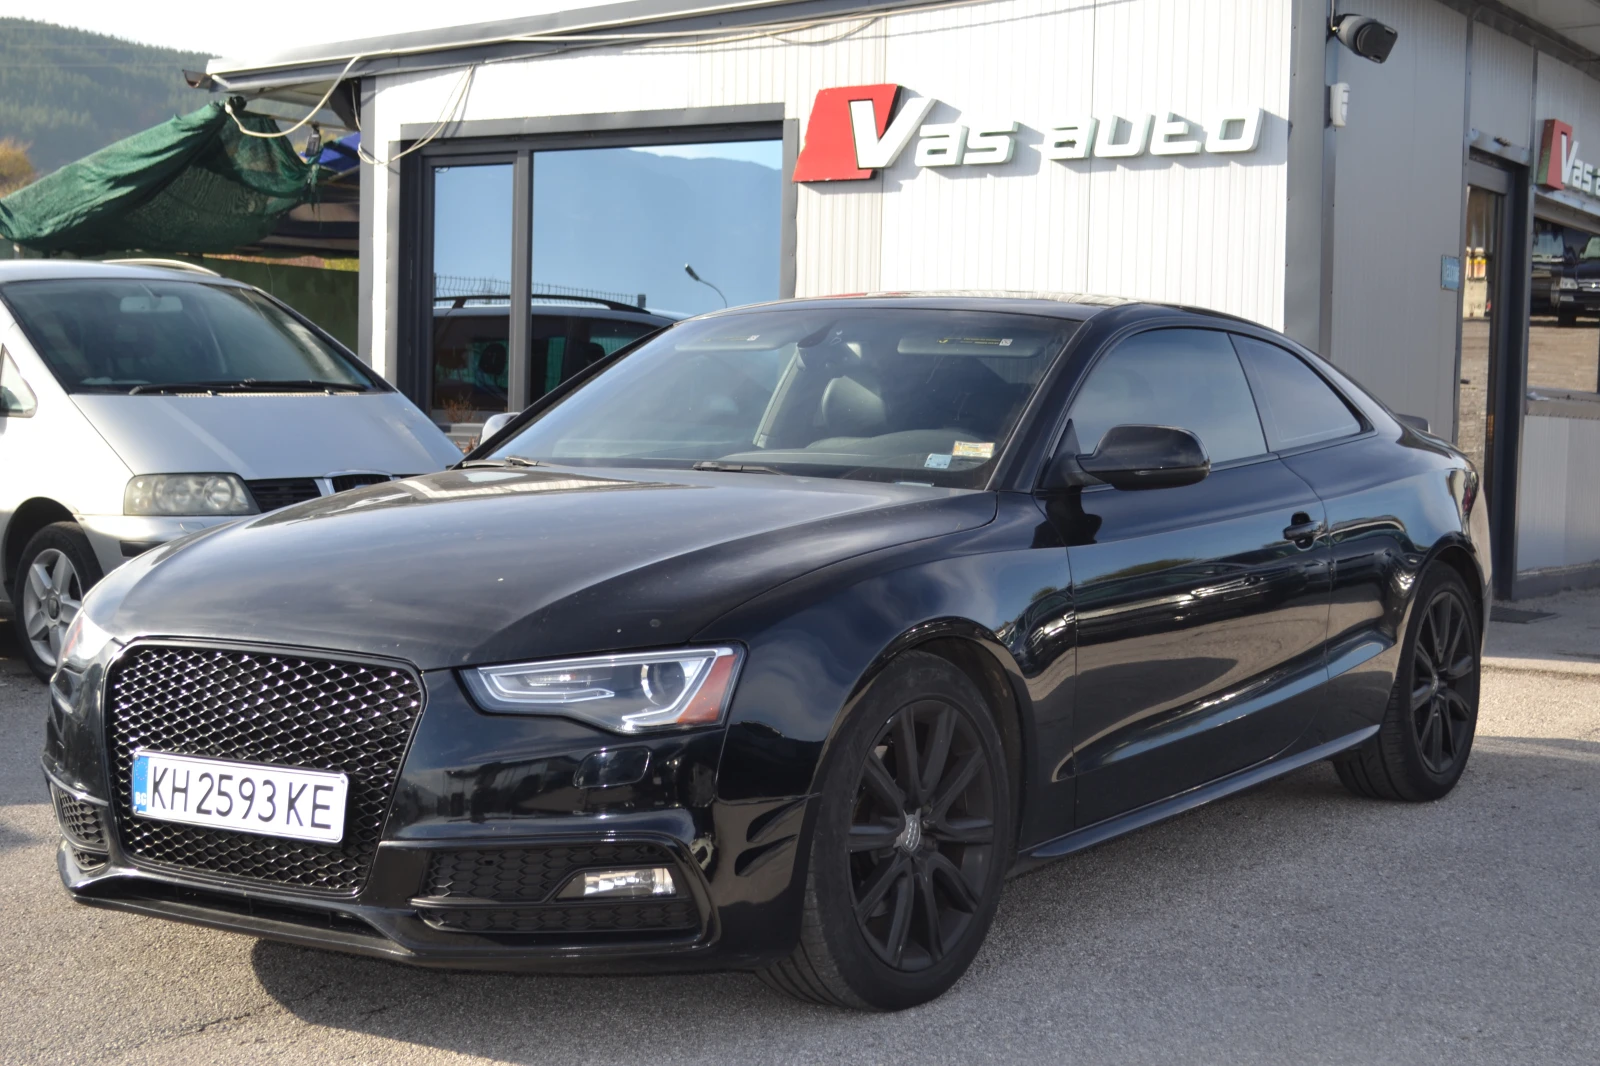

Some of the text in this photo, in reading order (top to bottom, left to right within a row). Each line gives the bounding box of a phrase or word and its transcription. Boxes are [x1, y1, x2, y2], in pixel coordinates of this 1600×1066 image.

[849, 97, 1264, 168] Vas auto
[1561, 133, 1594, 192] Vas
[135, 791, 147, 806] BG
